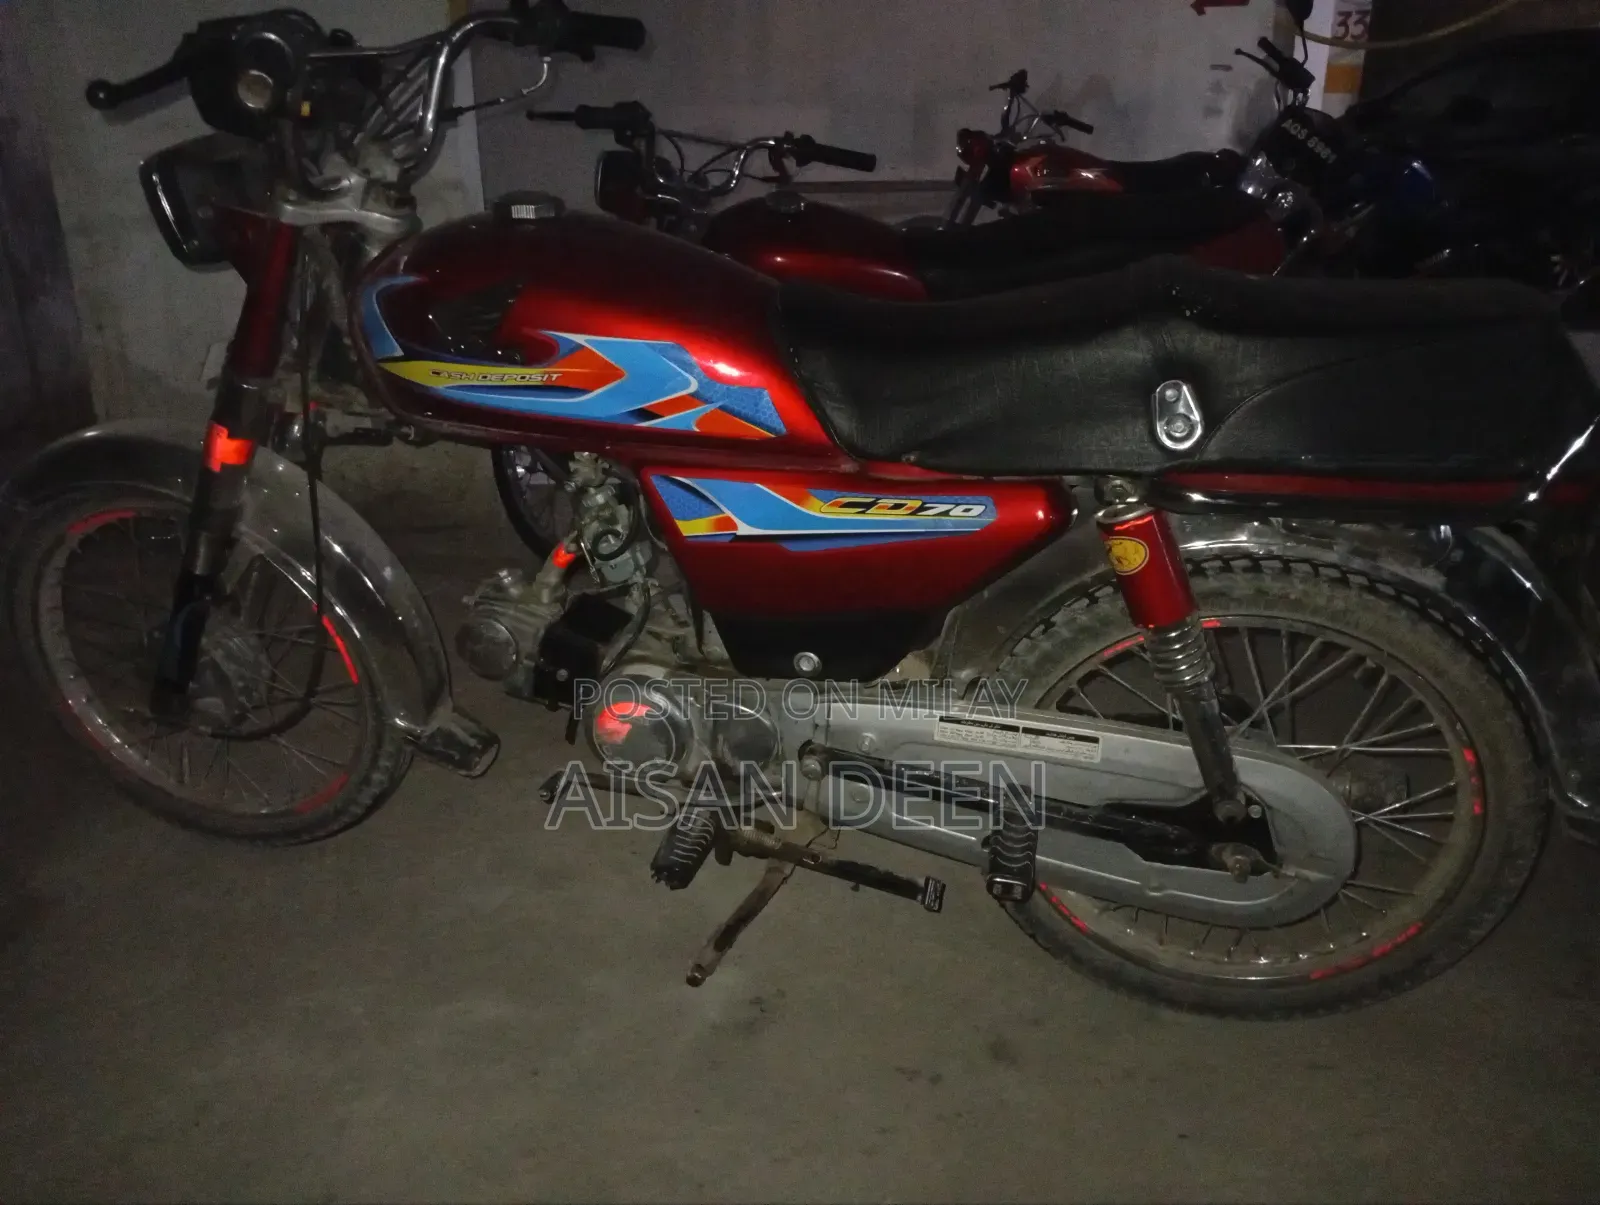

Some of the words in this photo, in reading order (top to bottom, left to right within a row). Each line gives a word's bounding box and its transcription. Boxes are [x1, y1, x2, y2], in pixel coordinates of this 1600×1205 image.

[1335, 10, 1370, 40] 33
[429, 369, 475, 380] CASH
[478, 373, 563, 382] DEPOSIT
[820, 496, 987, 517] CD70
